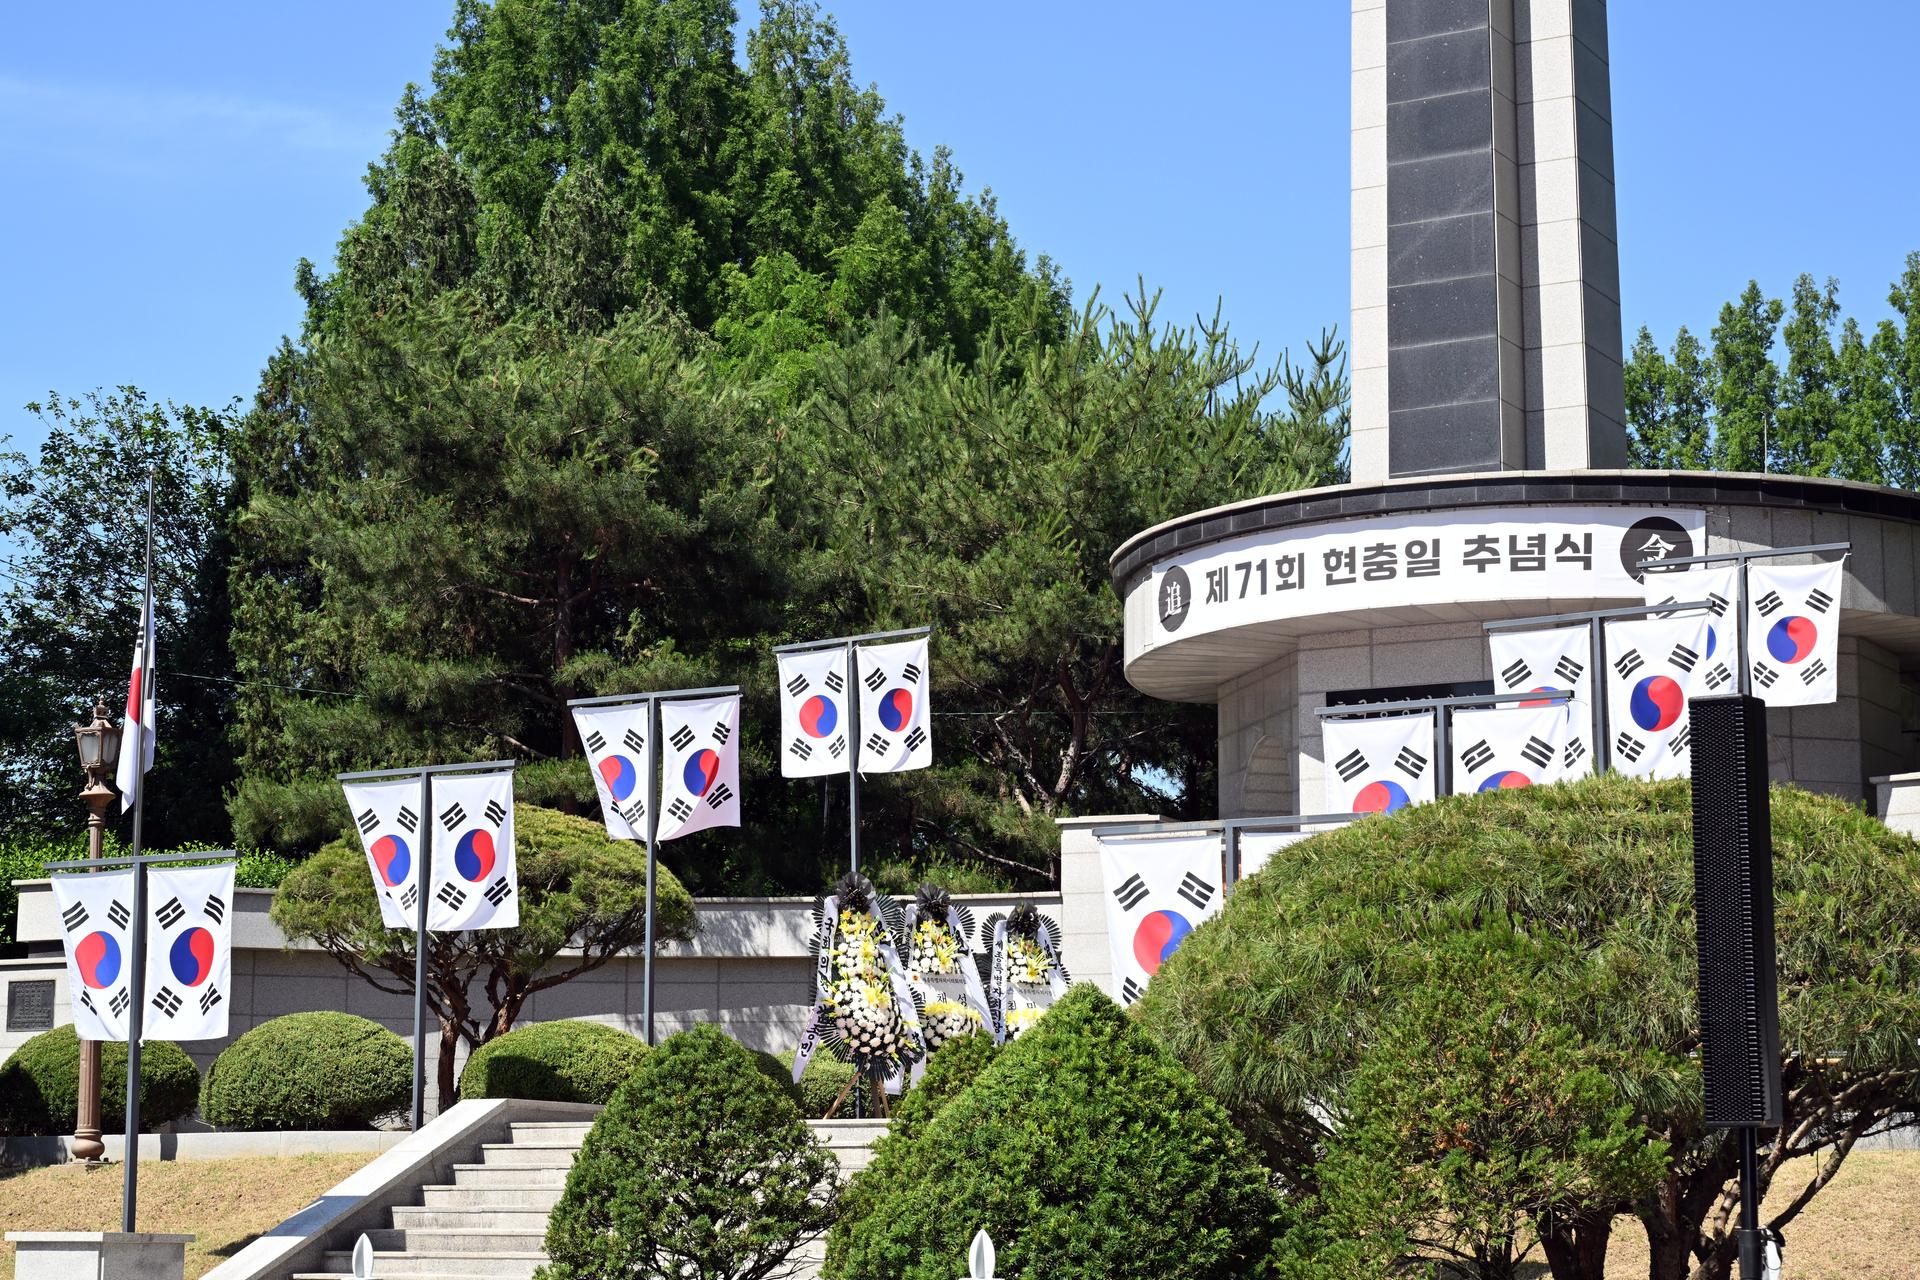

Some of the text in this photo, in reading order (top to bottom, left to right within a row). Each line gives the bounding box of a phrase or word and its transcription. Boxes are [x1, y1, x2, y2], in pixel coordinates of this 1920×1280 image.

[1205, 532, 1593, 605] 제71회 현충일 추념식
[1164, 581, 1183, 617] 追
